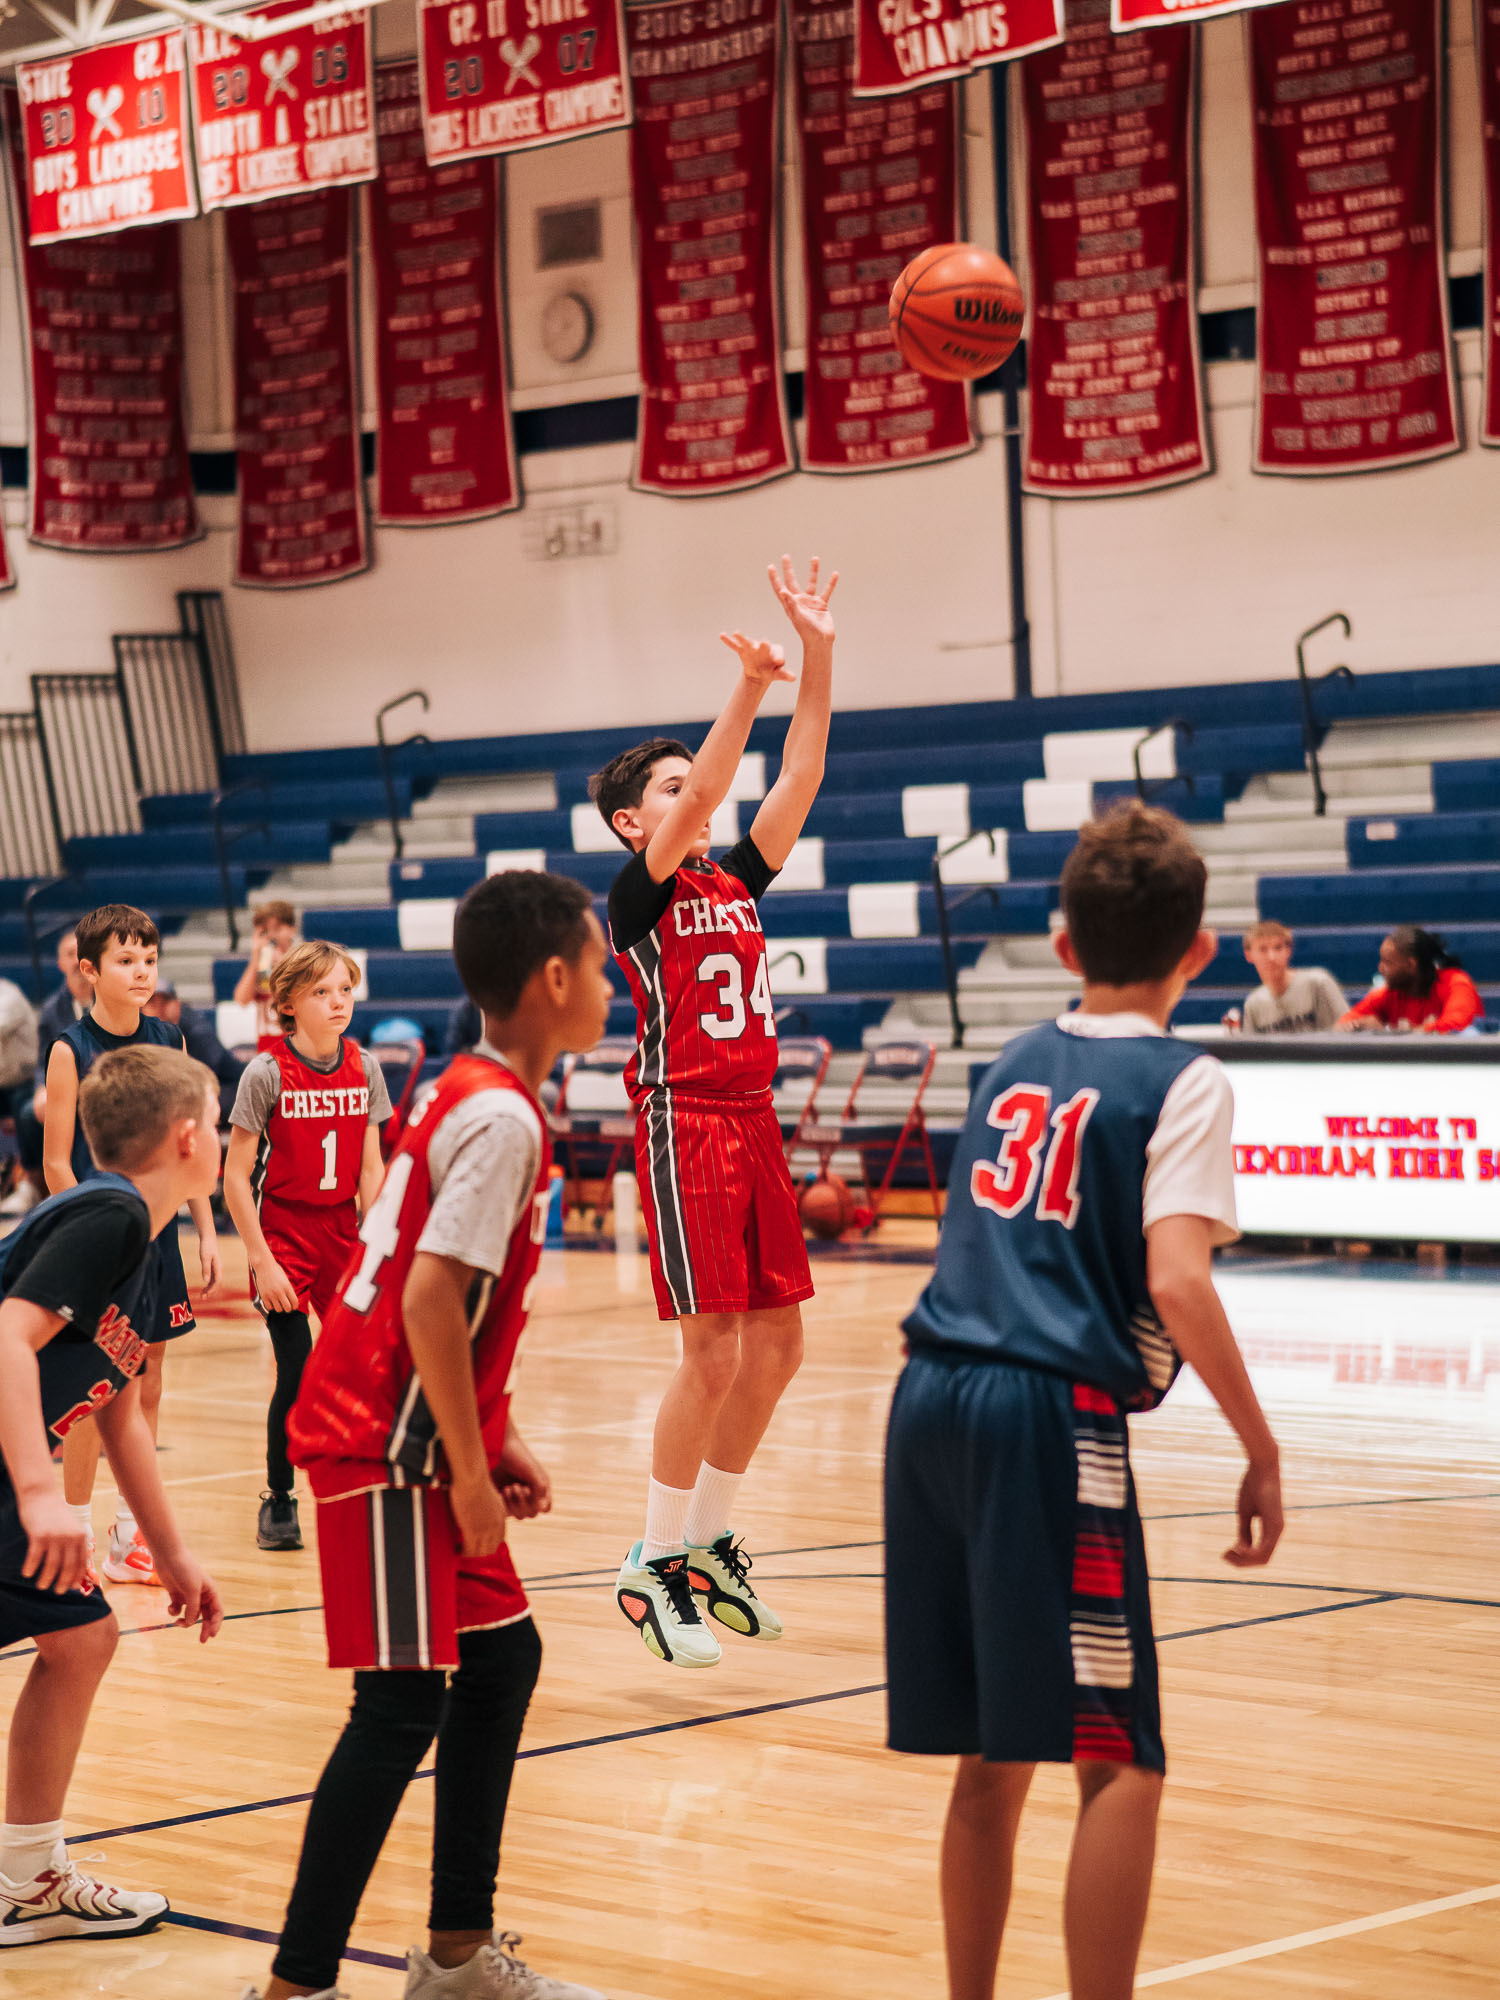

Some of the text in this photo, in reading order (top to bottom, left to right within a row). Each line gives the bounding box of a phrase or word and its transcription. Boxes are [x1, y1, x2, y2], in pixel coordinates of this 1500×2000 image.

[304, 86, 367, 139] STATE
[954, 296, 1024, 324] Wilso
[673, 897, 763, 937] CHEST
[697, 952, 777, 1042] 34
[280, 1086, 369, 1119] CHESTER
[1324, 1115, 1478, 1142] WELCOME TO
[318, 1129, 339, 1192] 1
[969, 1081, 1102, 1231] 31
[1232, 1144, 1376, 1178] ENDHAM
[1389, 1146, 1465, 1181] HIGH
[168, 1300, 194, 1328] M
